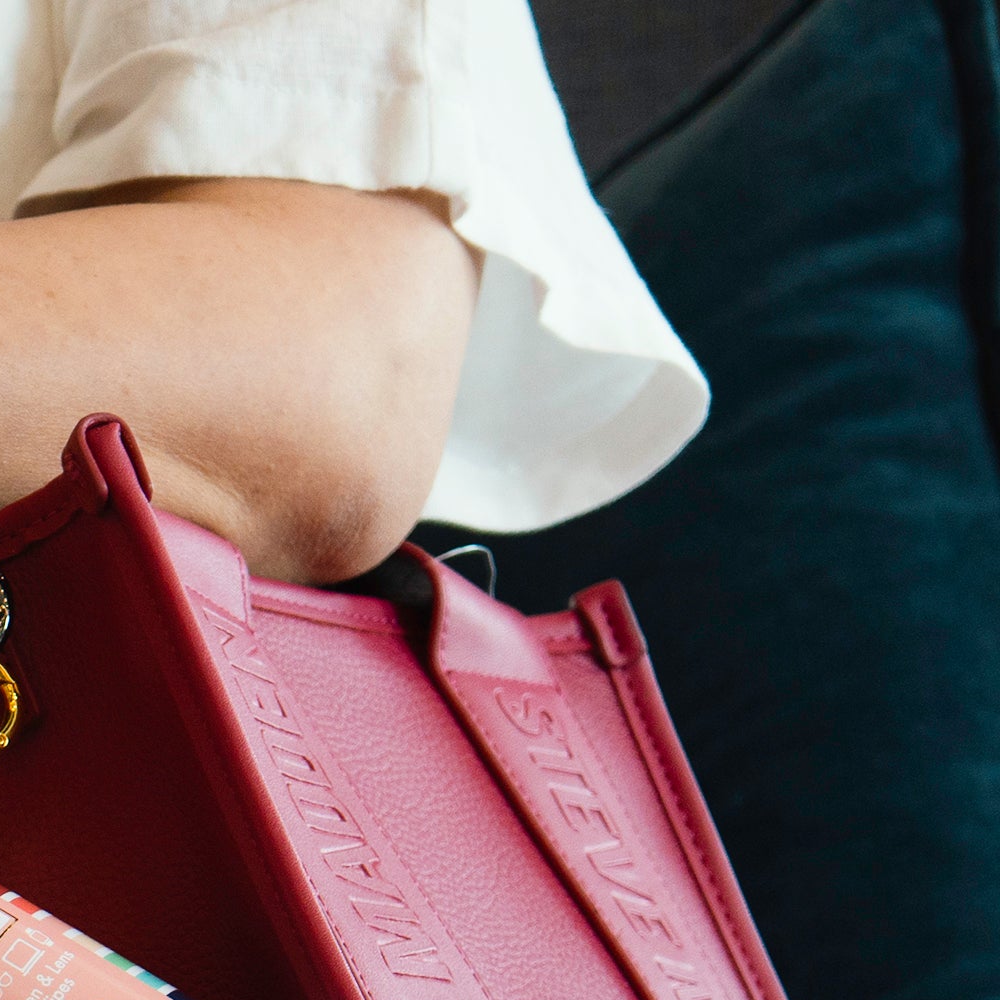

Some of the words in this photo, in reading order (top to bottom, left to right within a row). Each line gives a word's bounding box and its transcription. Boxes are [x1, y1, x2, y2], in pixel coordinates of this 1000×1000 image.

[203, 605, 453, 983] MADDEN
[494, 686, 682, 950] STEVE
[36, 973, 54, 987] &
[45, 951, 75, 975] Lens
